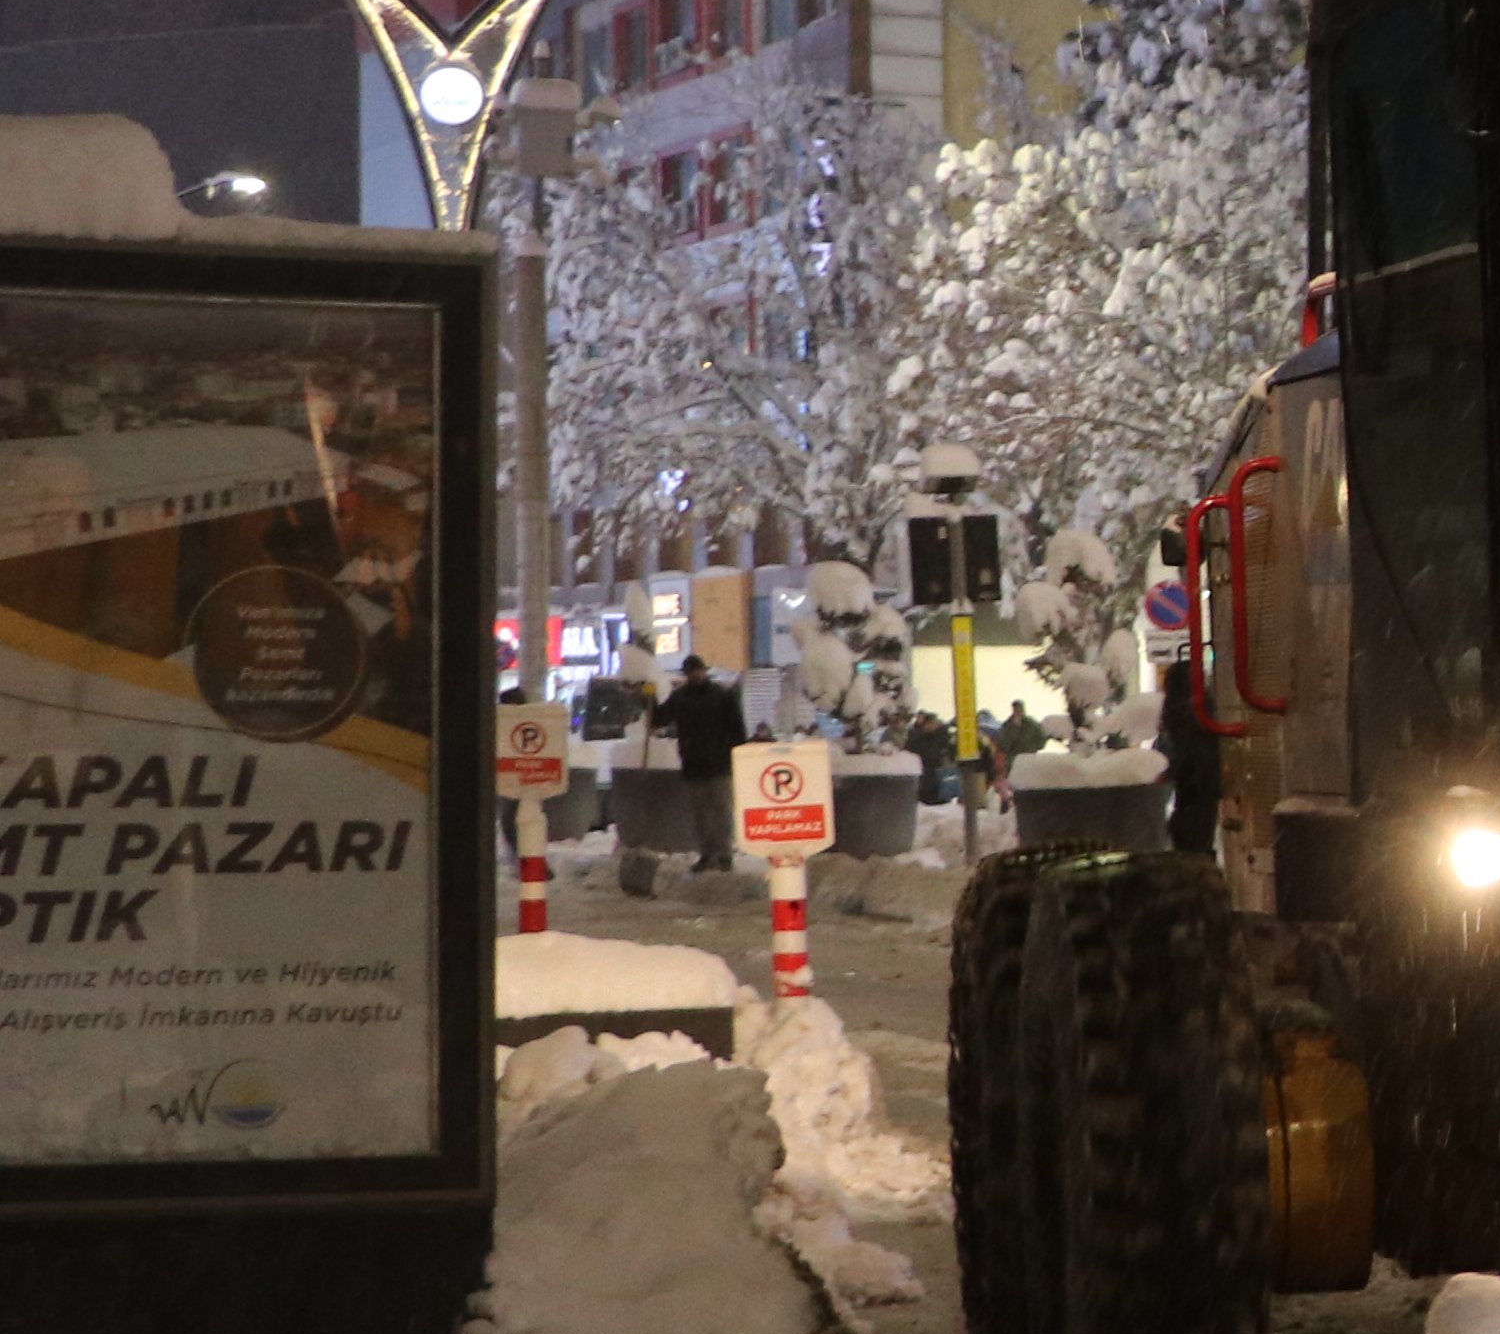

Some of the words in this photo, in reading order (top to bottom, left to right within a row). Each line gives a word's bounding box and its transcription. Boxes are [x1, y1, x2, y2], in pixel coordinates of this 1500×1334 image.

[0, 755, 259, 809] APALI
[105, 820, 413, 875] PAZARI
[109, 965, 225, 988] Modern
[235, 967, 268, 985] ve
[1, 1008, 129, 1033] Alışveriş
[286, 1002, 401, 1027] Kavuştu
